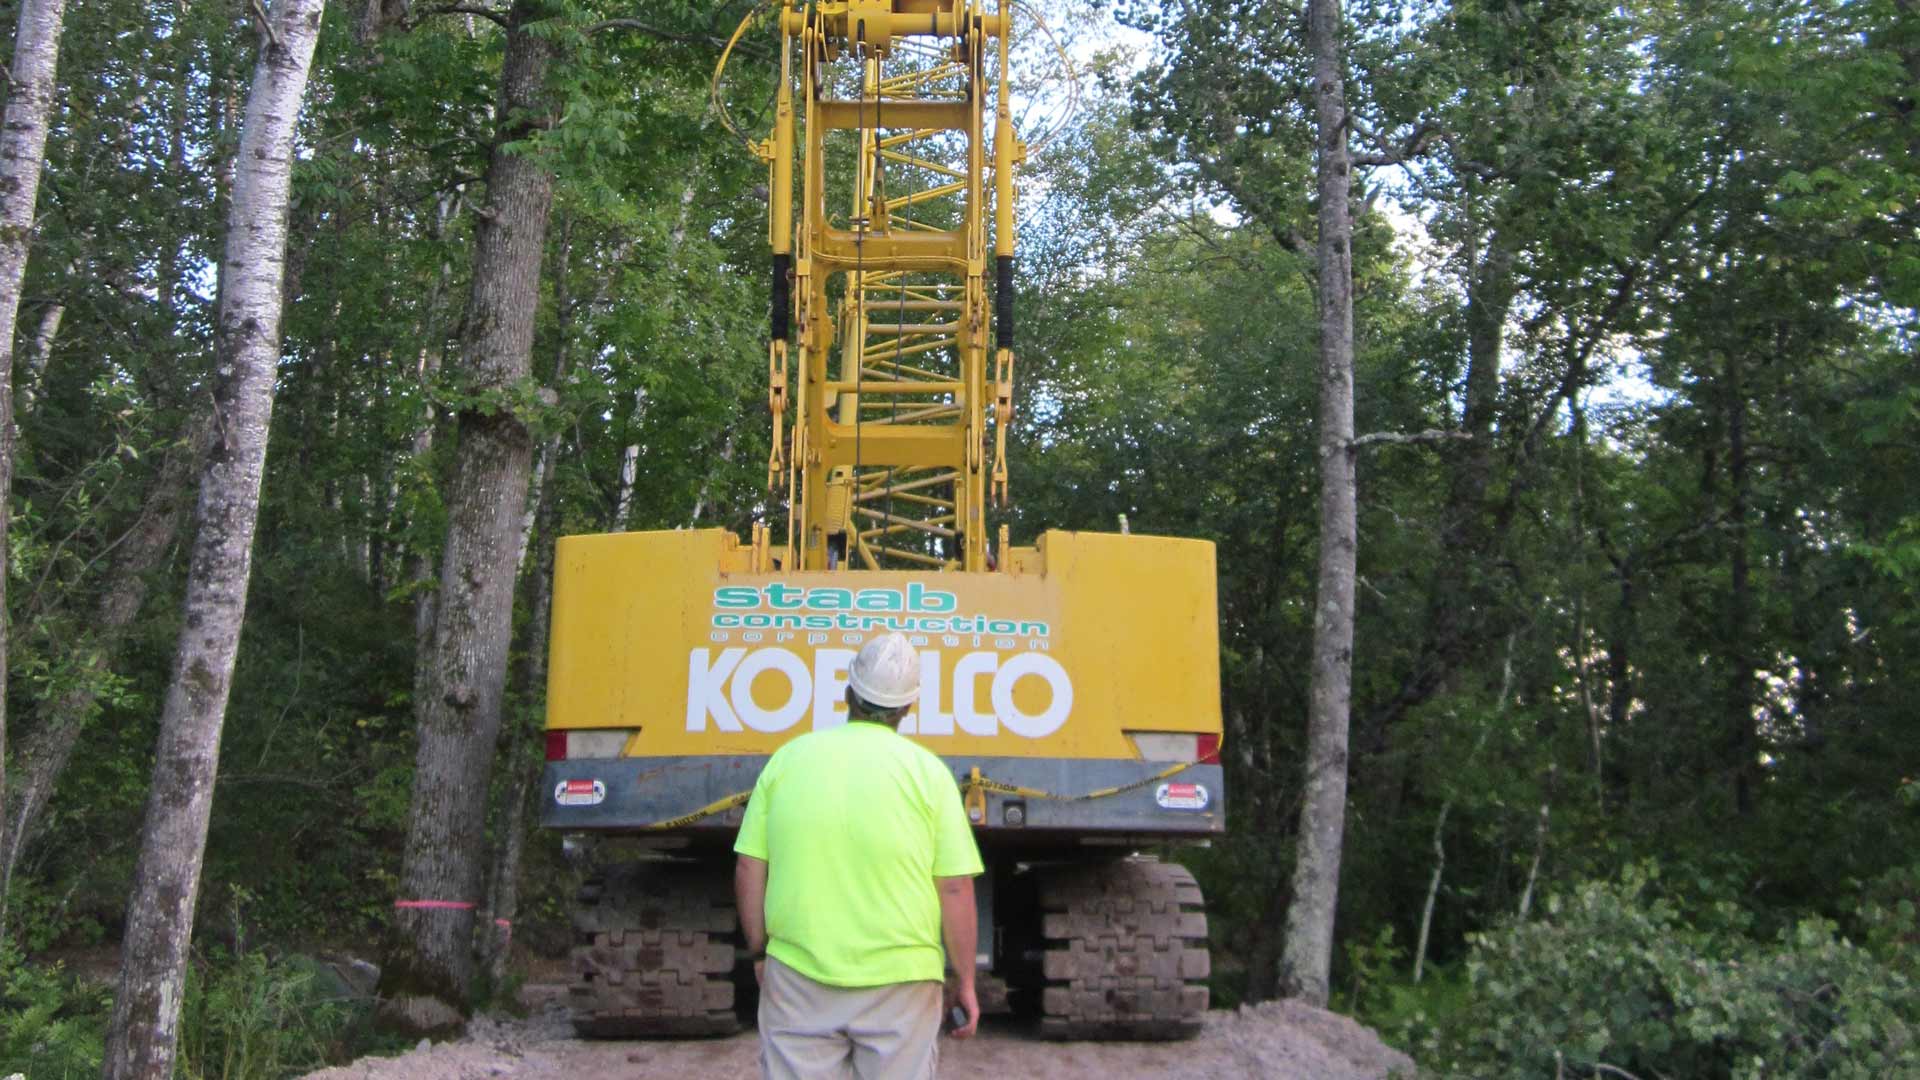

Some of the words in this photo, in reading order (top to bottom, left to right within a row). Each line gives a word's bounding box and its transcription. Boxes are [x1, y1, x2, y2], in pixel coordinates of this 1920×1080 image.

[714, 582, 957, 613] staab
[711, 613, 1050, 637] construction
[710, 630, 1049, 649] corpoation
[686, 647, 1073, 738] KOBLCO
